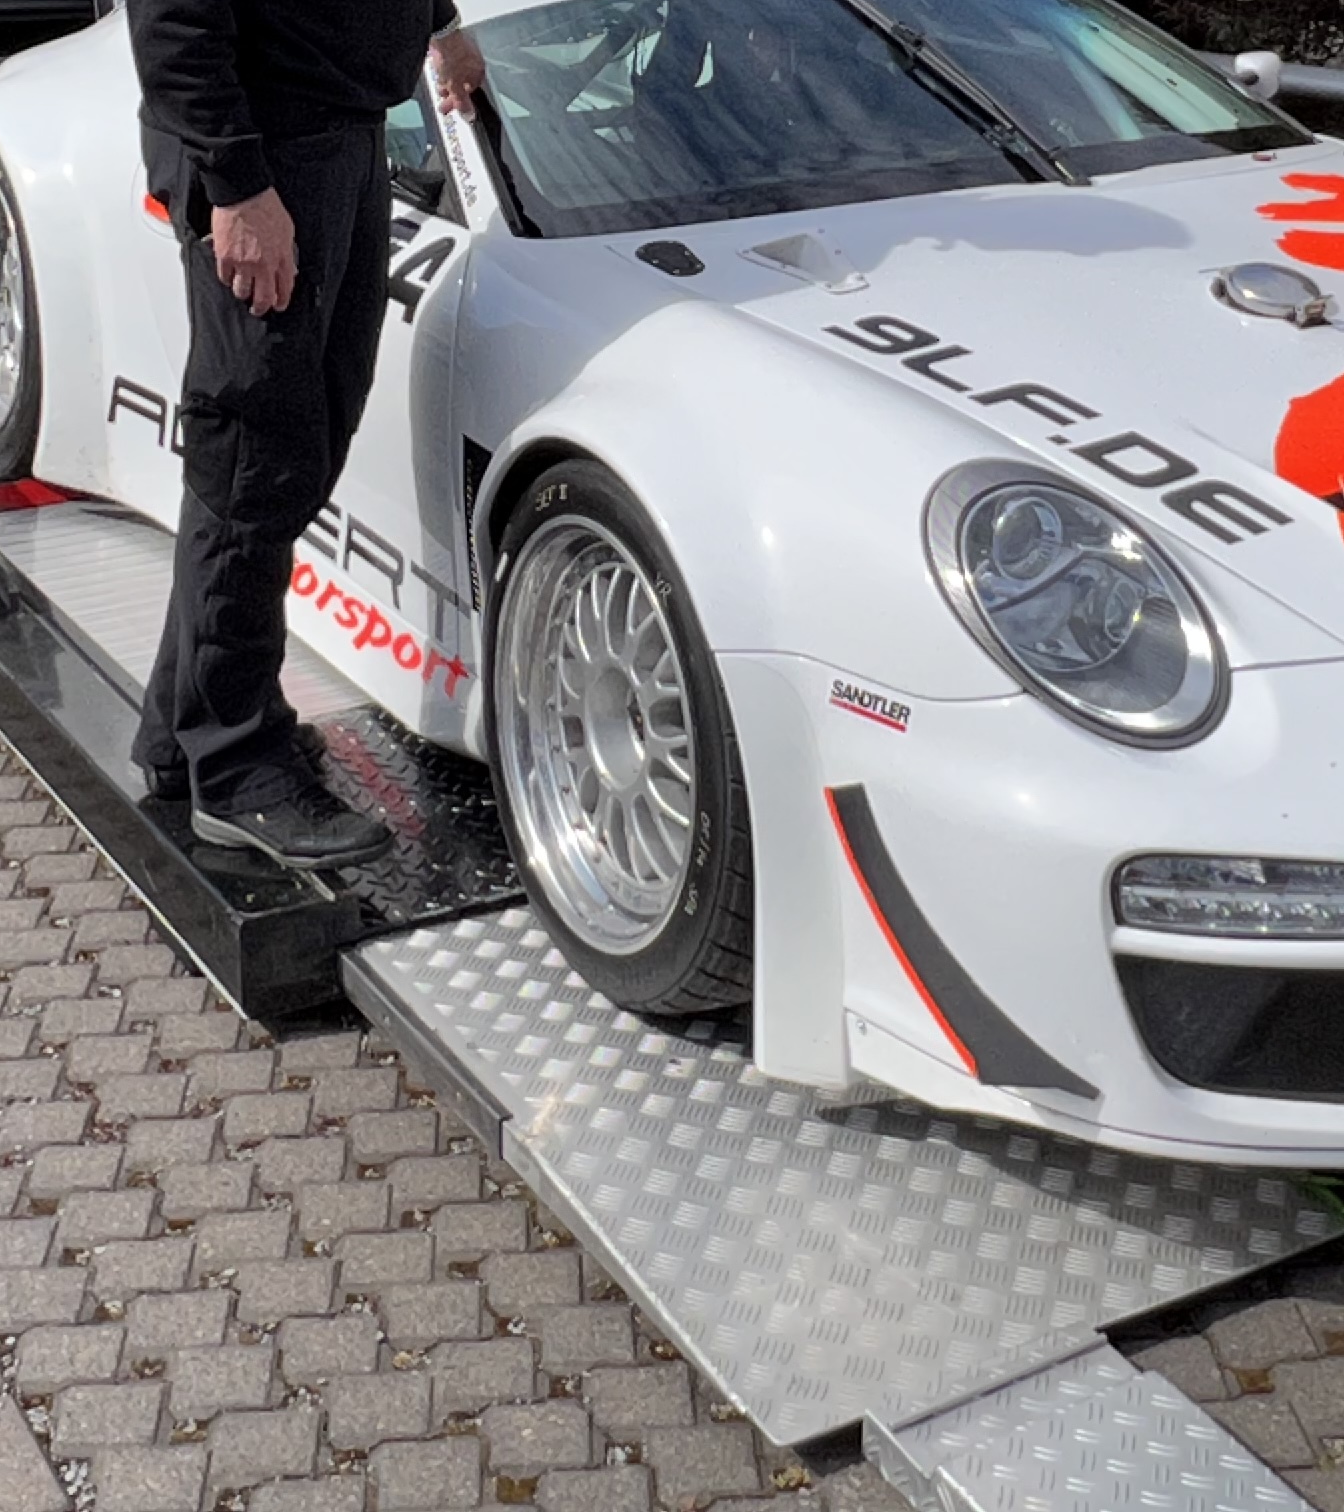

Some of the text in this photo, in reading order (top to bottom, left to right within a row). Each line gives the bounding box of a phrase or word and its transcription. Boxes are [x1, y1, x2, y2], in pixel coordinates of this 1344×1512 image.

[388, 217, 457, 324] 4
[822, 315, 1294, 545] 9LF.DE
[291, 558, 470, 700] orsport
[831, 678, 911, 724] SANDTLER
